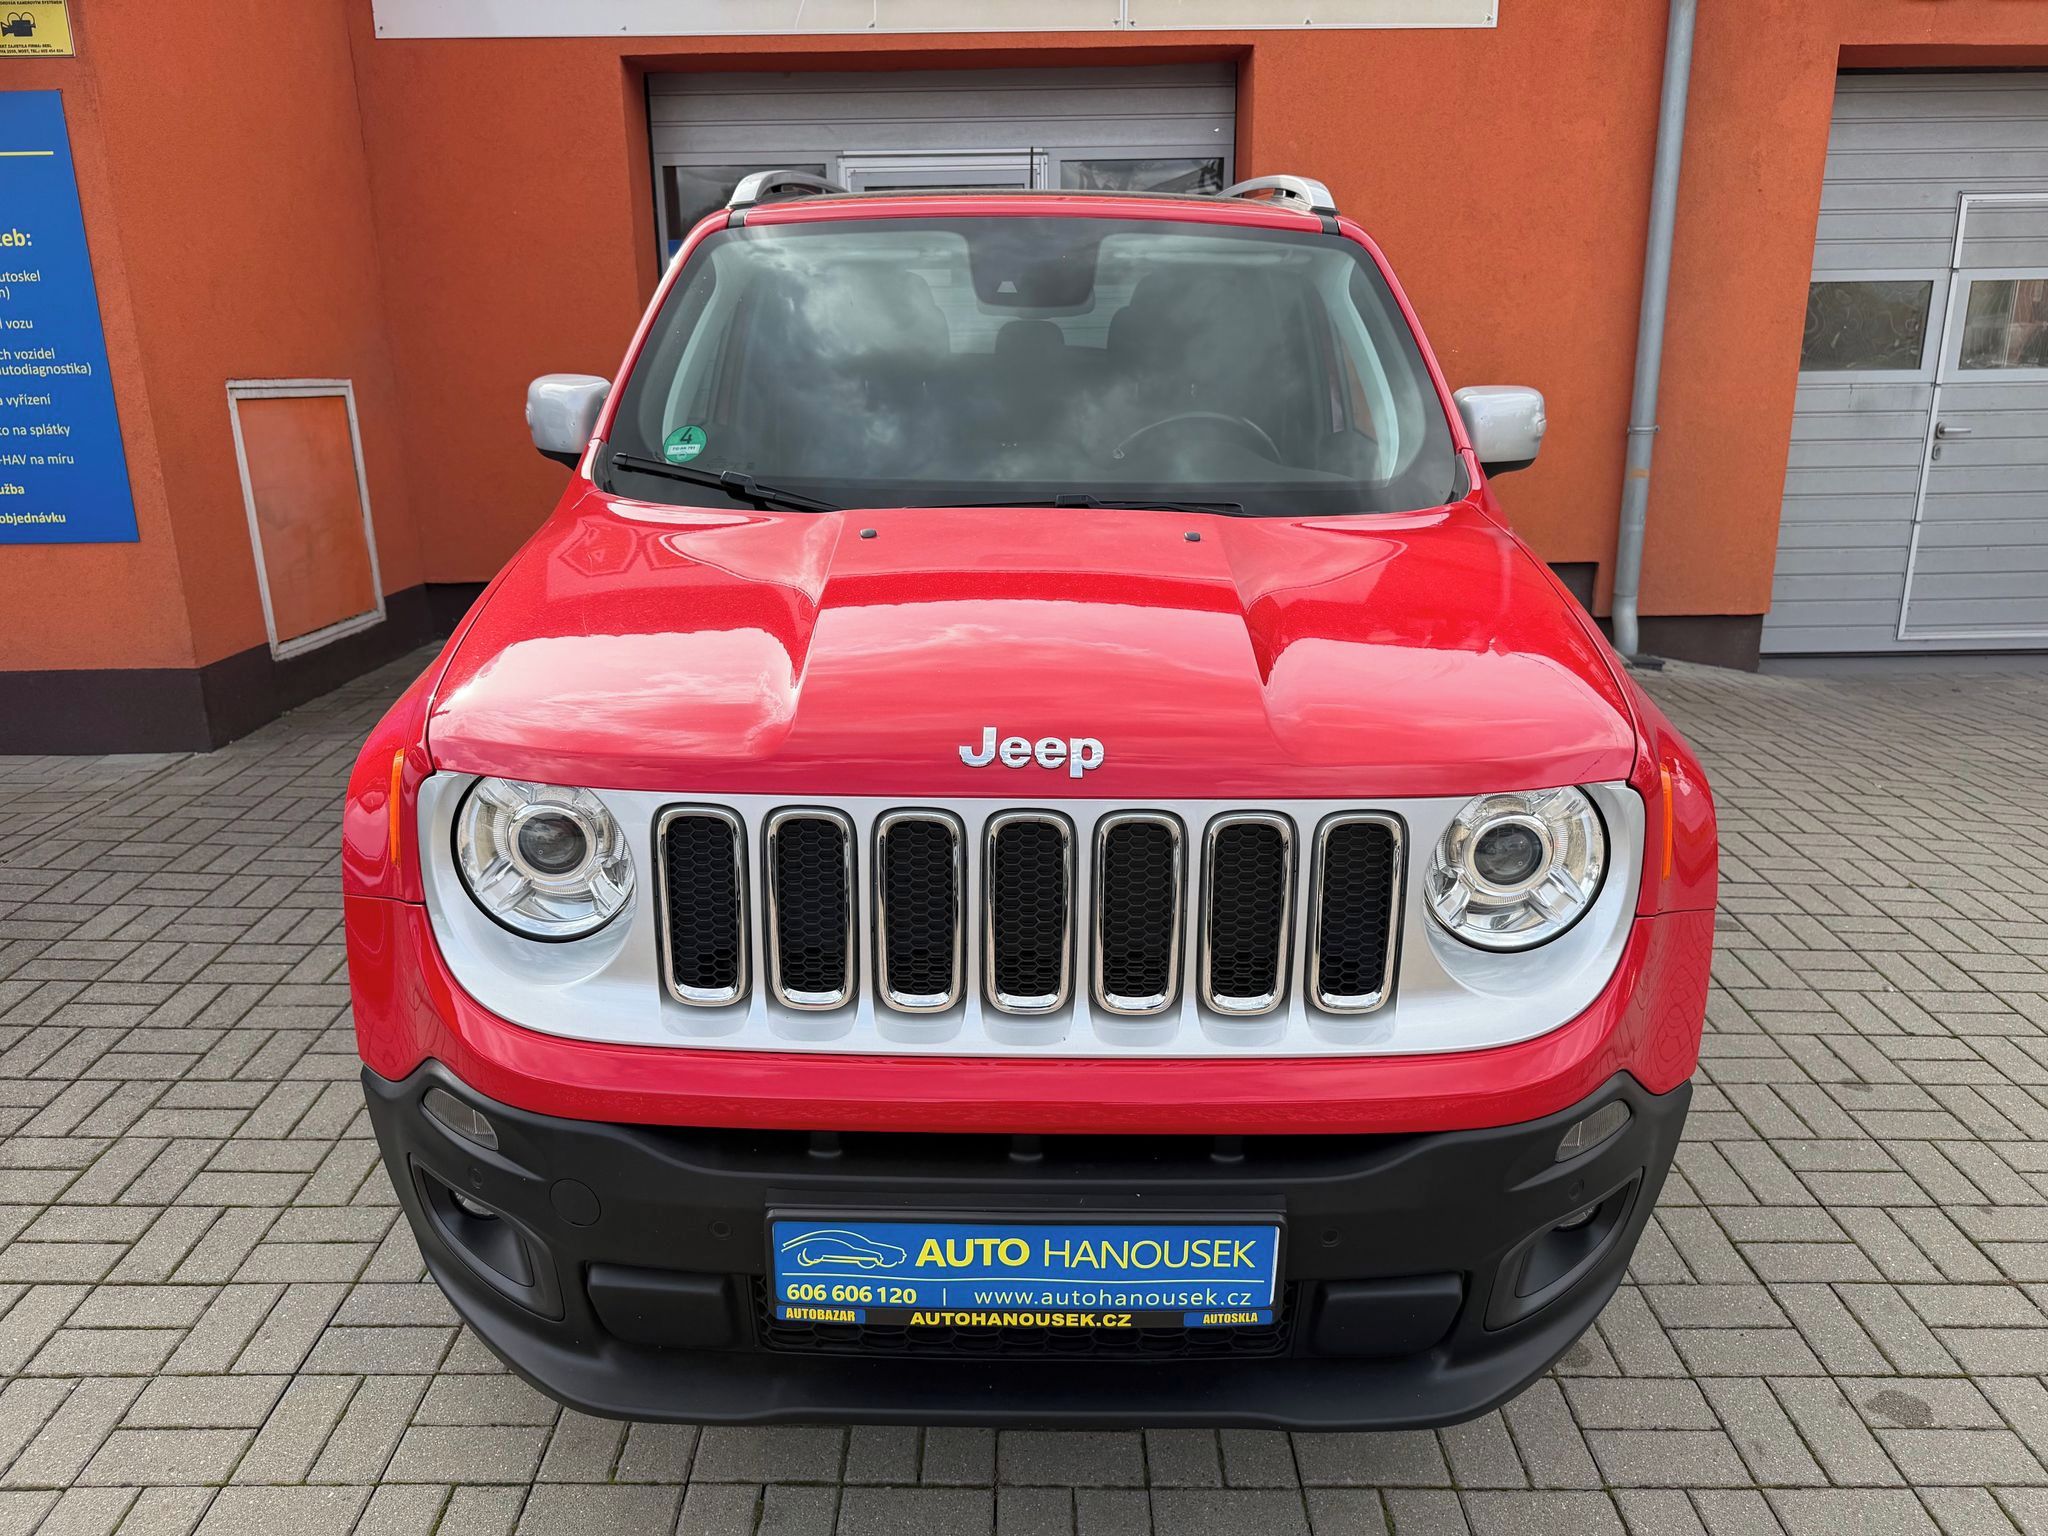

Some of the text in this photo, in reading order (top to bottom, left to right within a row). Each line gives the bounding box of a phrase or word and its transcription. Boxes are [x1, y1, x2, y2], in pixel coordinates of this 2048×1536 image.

[0, 228, 33, 247] eb:
[5, 319, 34, 329] vozu
[14, 347, 55, 360] vozidel
[0, 362, 92, 377] utodiagnostika)
[5, 393, 51, 408] vyřízení
[12, 426, 27, 436] na
[30, 423, 70, 438] splátky
[680, 427, 692, 445] 4
[30, 455, 44, 465] na
[47, 453, 74, 465] míru
[0, 511, 66, 526] objednávku
[958, 726, 1105, 779] Jeep
[915, 1237, 1257, 1269] AUTO HANOUSEK
[786, 1283, 917, 1304] 606 606 120
[974, 1287, 1253, 1306] www.autohanousek.cz
[785, 1307, 856, 1322] AUTOBAZAR
[910, 1311, 1132, 1328] AUTOHANOUSEK.CZ
[1203, 1312, 1258, 1325] AUTOSKLA
